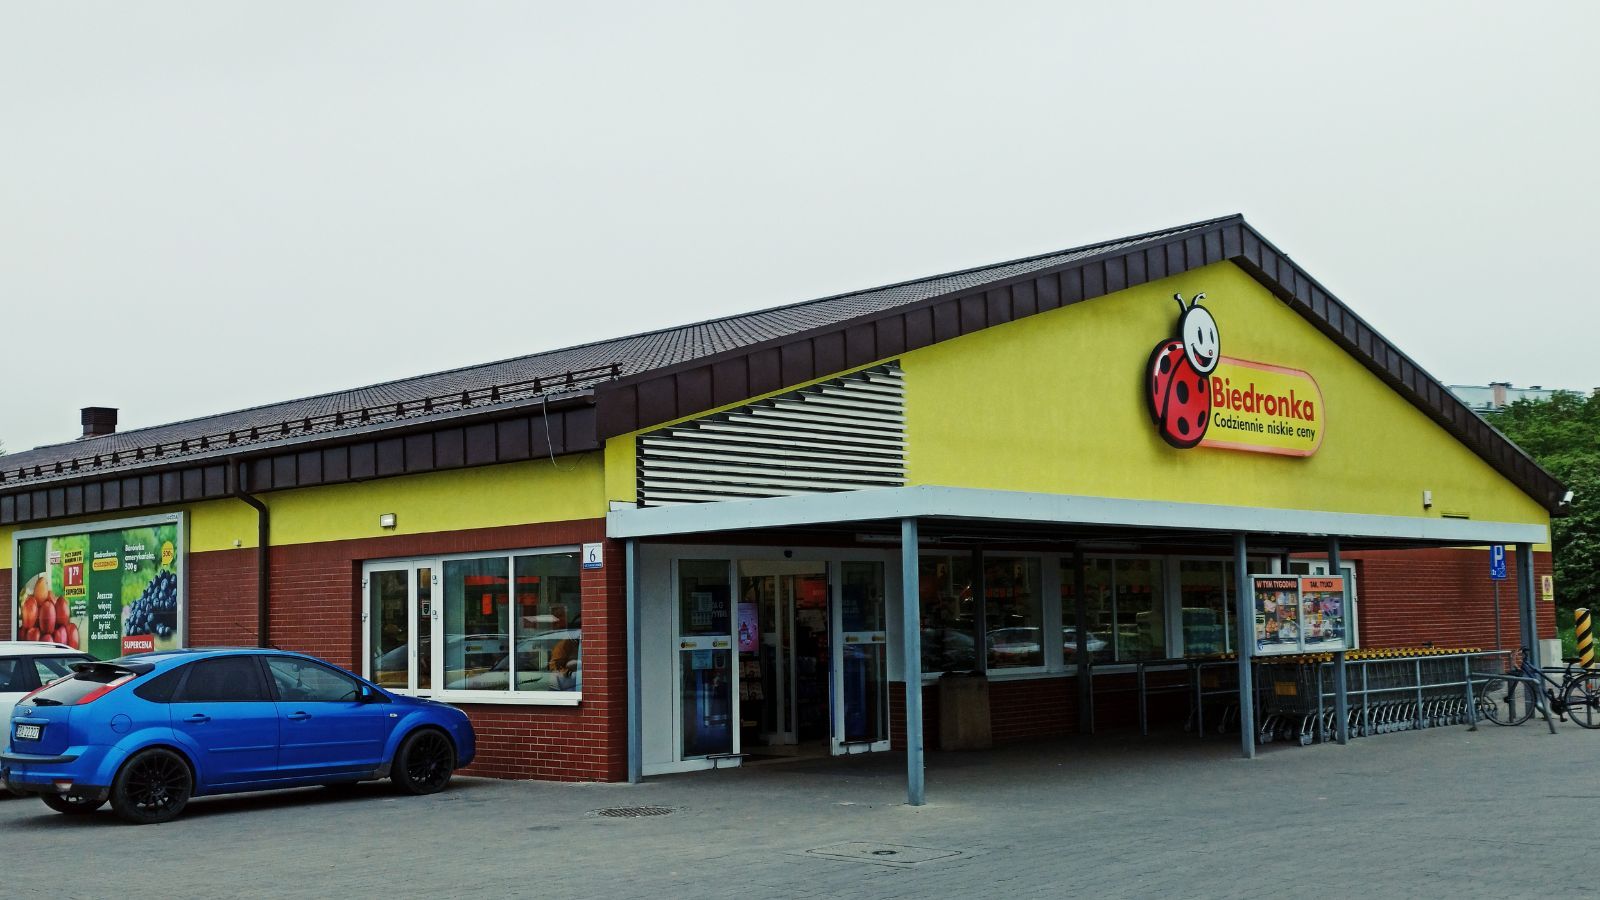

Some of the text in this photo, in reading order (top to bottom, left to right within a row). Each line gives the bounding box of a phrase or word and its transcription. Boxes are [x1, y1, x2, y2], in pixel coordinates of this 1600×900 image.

[1212, 377, 1314, 421] Biedronka
[1214, 412, 1316, 441] Codziennie niskie ceny
[590, 548, 596, 562] 6
[1494, 545, 1503, 567] P
[125, 562, 133, 570] 500
[1256, 580, 1297, 588] W TYM TYGODNIU
[66, 588, 85, 596] SUPERCENA
[97, 592, 113, 600] Jeszcze
[98, 600, 112, 611] więcej
[98, 631, 118, 640] Biedronki
[124, 640, 152, 649] SUPERCENA
